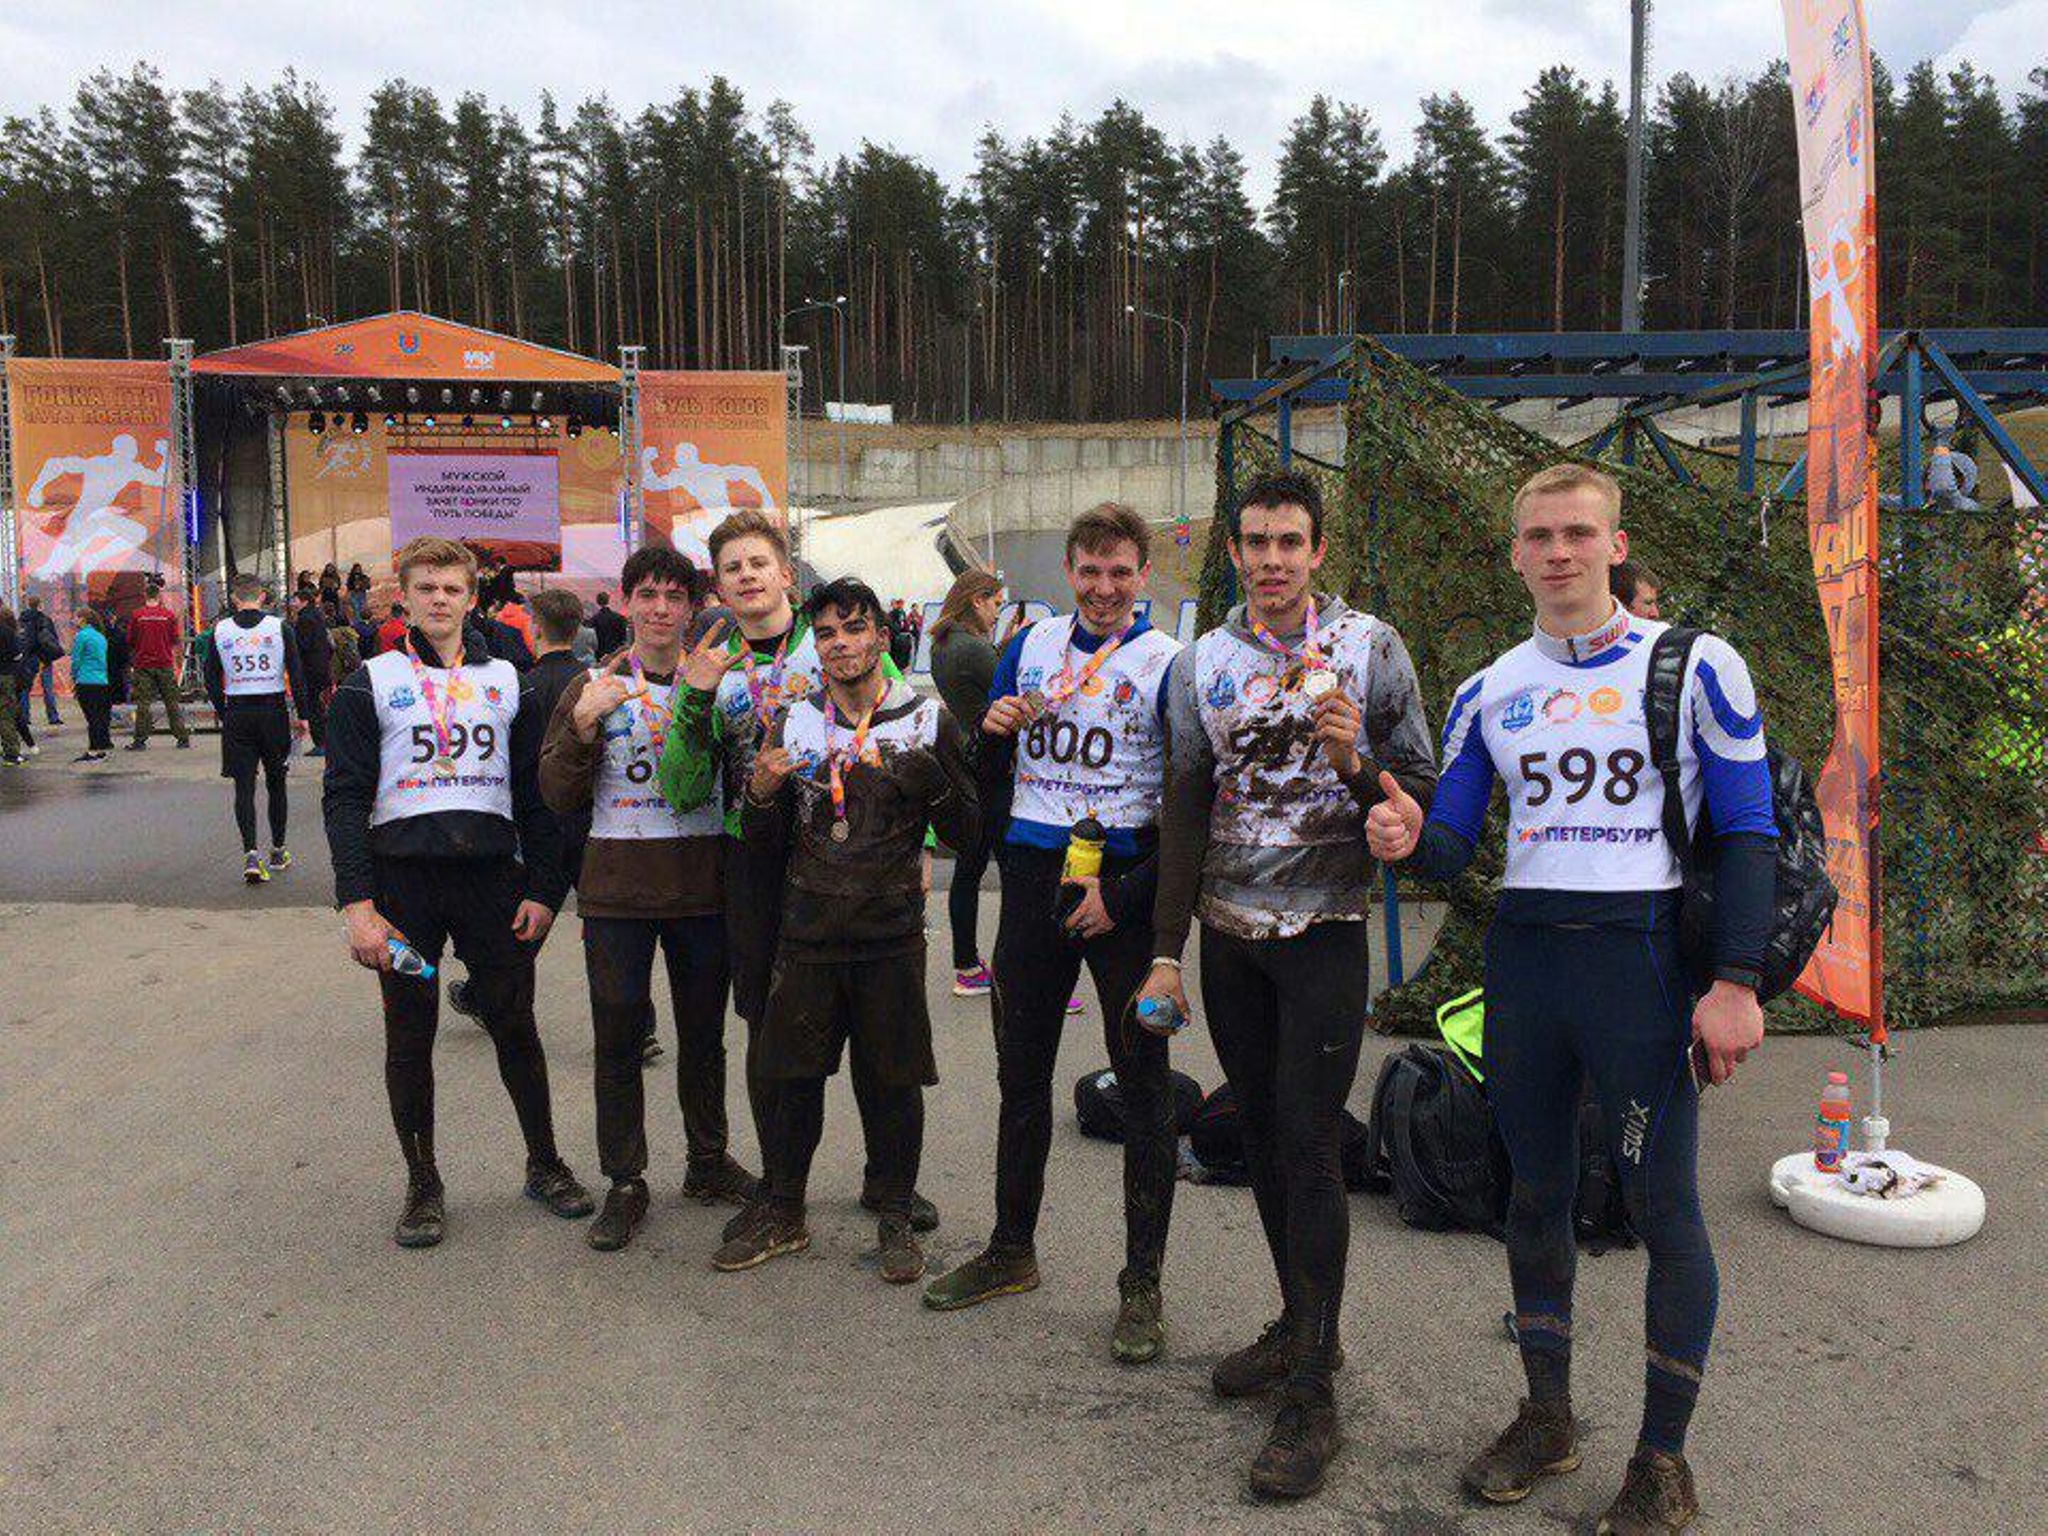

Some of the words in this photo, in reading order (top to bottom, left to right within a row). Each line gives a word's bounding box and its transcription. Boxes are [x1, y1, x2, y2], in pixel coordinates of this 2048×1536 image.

[441, 470, 506, 482] МУЖСКОЙ
[414, 482, 532, 495] ИНДИВИДУАЛЬНЫЙ
[231, 653, 271, 674] 358
[411, 723, 497, 764] 599
[1519, 747, 1645, 807] 598
